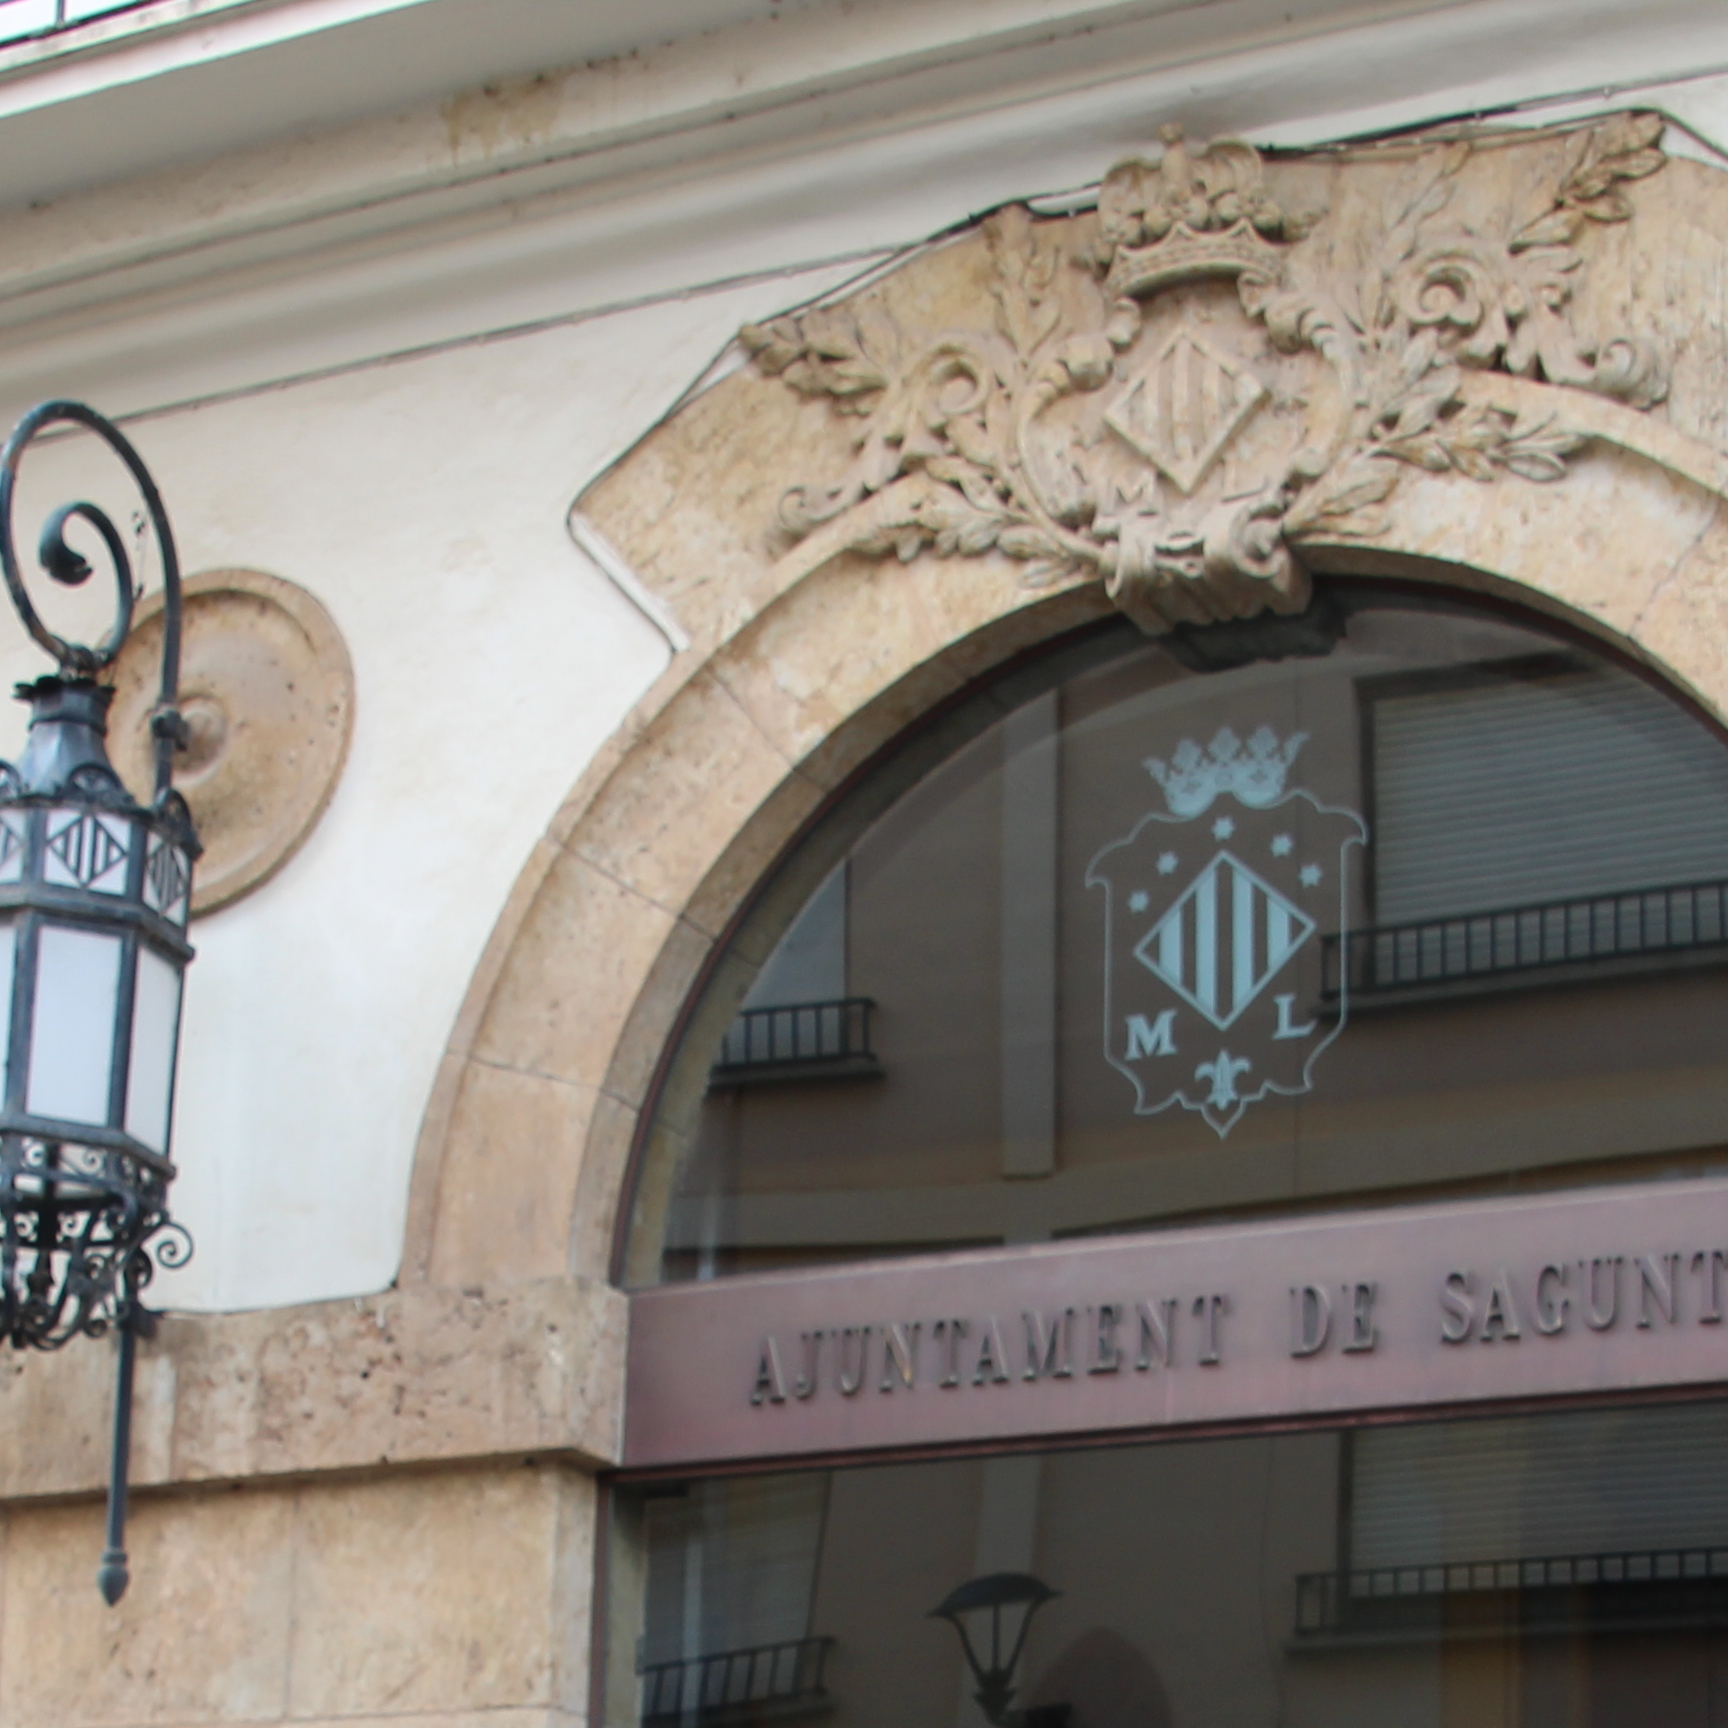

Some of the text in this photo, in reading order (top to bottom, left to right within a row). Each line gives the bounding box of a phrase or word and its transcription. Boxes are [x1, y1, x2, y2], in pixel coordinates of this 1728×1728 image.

[1124, 1009, 1178, 1061] M
[1271, 993, 1318, 1040] L
[748, 1290, 1234, 1406] AJUNTAMENT
[1289, 1279, 1379, 1359] DE
